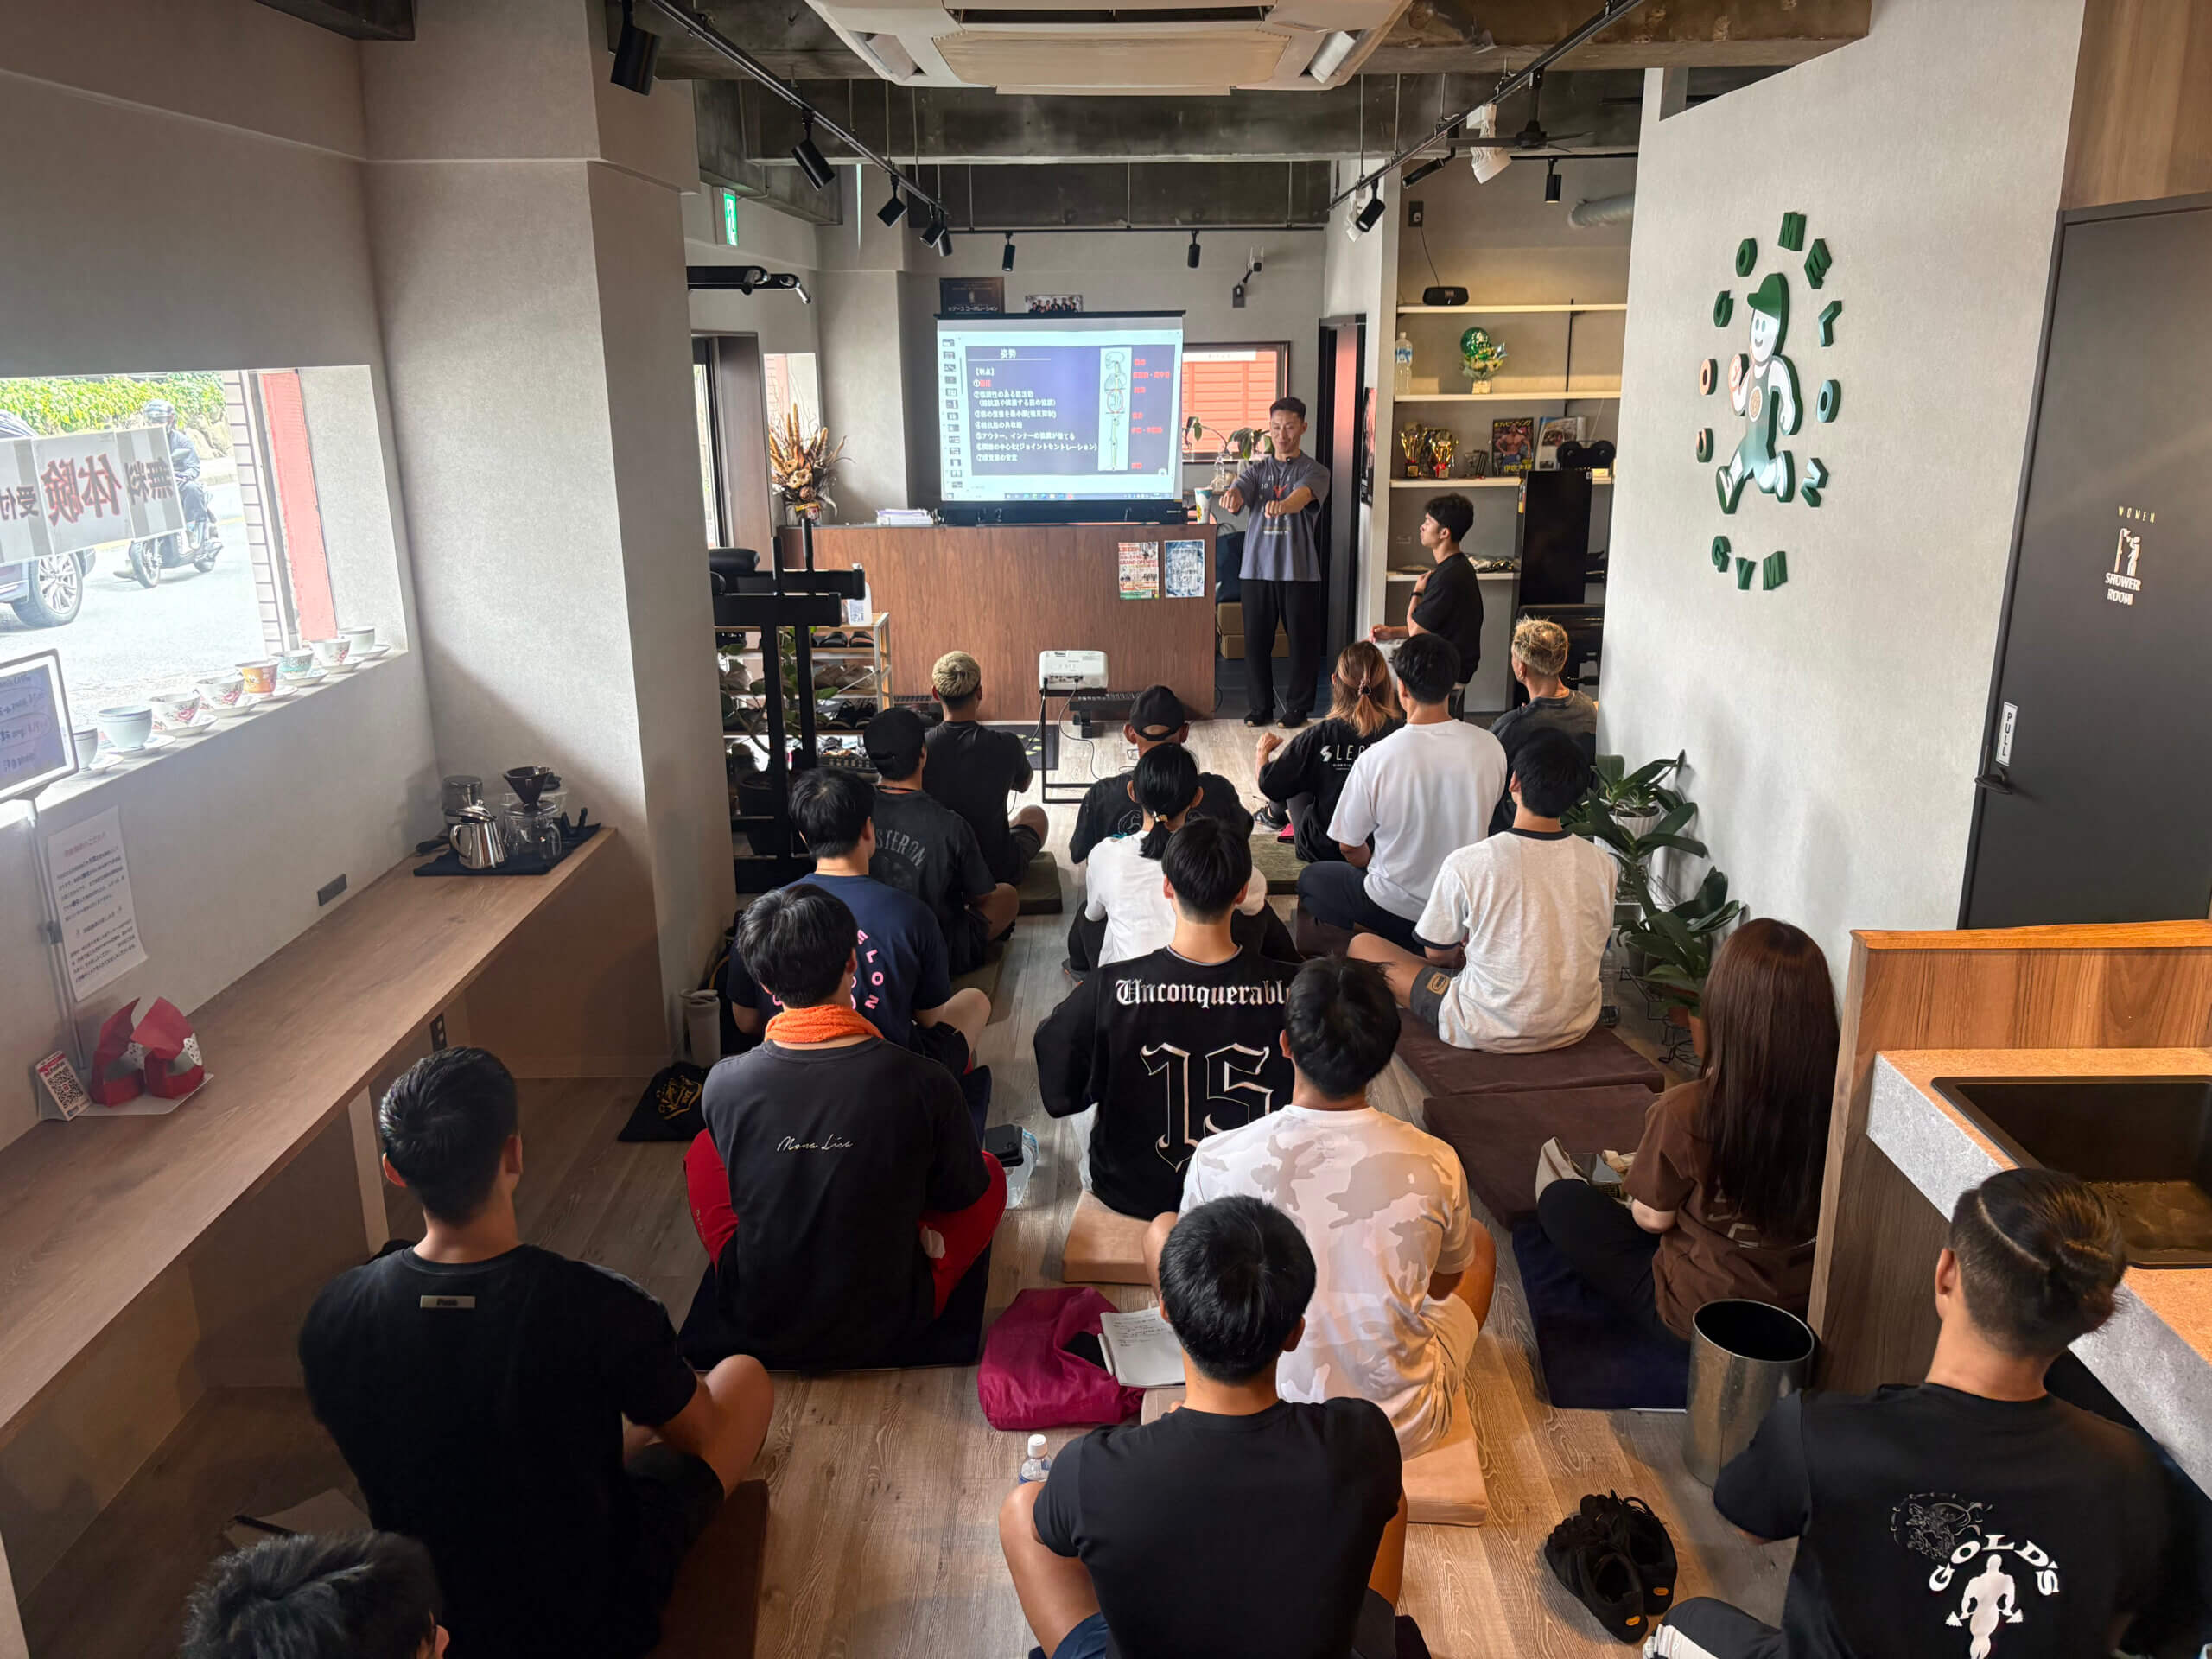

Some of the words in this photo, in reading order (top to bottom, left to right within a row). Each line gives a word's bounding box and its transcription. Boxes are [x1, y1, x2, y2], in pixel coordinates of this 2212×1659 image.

[2118, 505, 2156, 524] WOMEN
[1711, 535, 1788, 591] GYM
[2104, 571, 2142, 592] SHOWER
[2107, 588, 2133, 606] ROOM
[2002, 711, 2012, 757] PULL
[1115, 979, 1291, 1009] Unconquerabl
[1140, 1042, 1274, 1173] 15
[1929, 1534, 2060, 1596] GOLD'S
